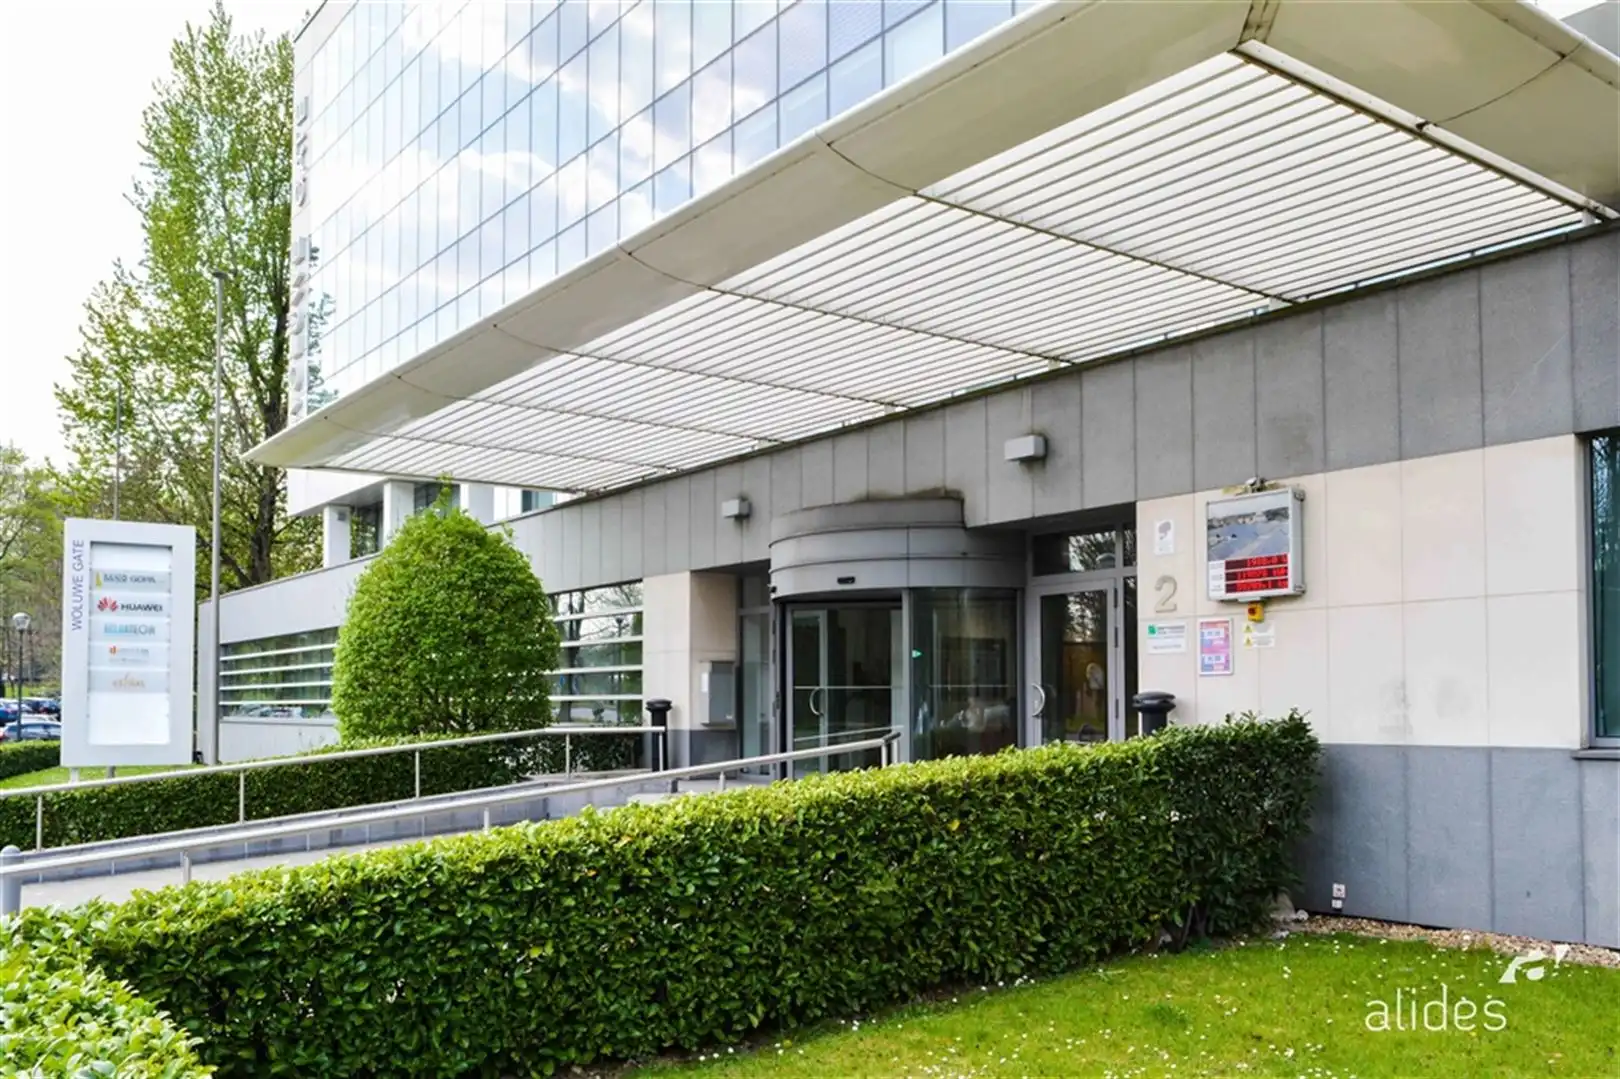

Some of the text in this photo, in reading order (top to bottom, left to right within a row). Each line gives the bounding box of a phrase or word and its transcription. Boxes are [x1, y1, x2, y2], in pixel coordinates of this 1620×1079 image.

[72, 539, 84, 631] WOLUWE GATE
[1155, 575, 1178, 613] 2
[120, 602, 164, 612] HUAWEI
